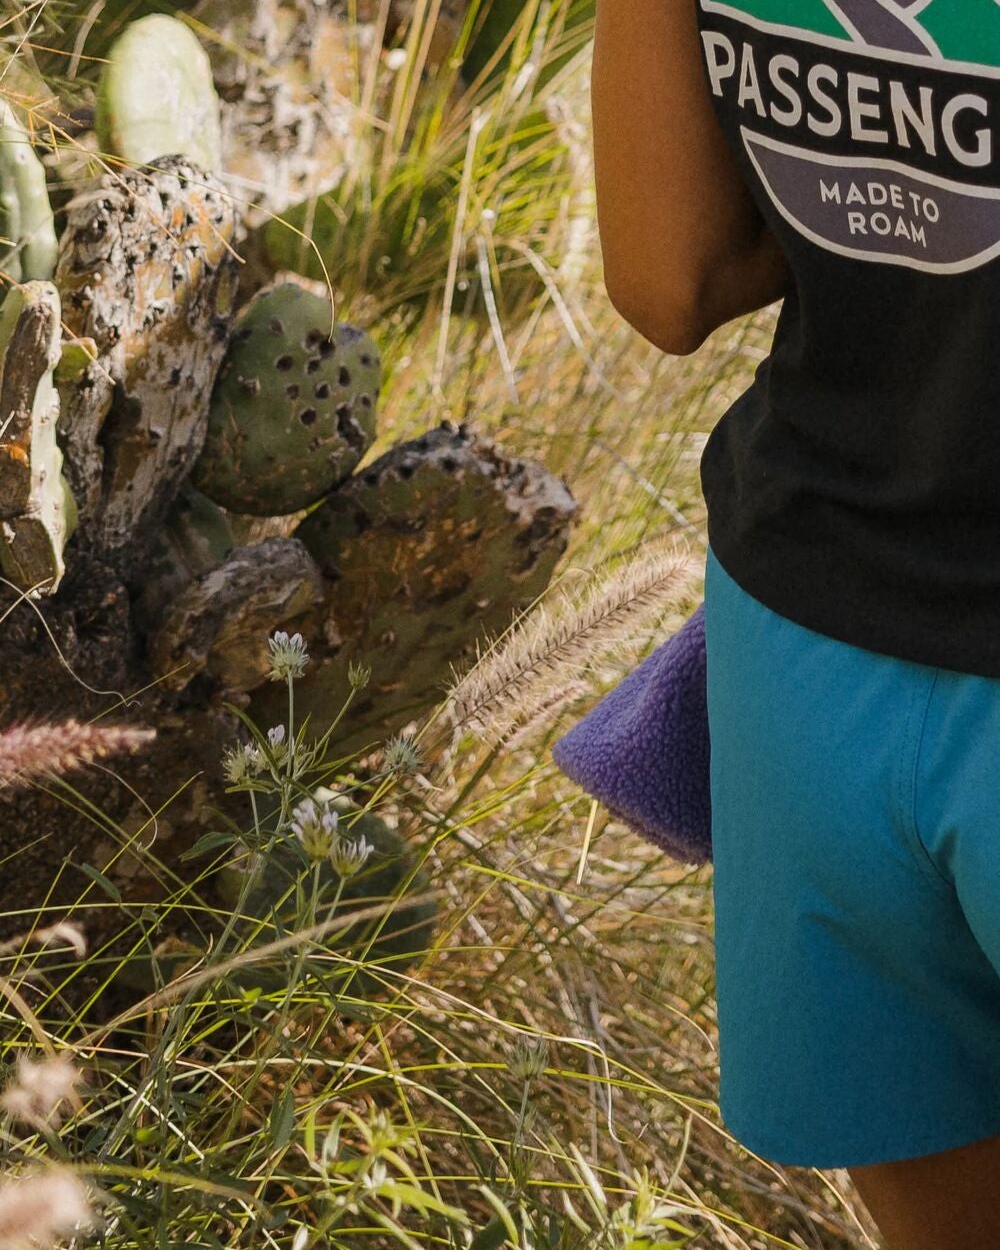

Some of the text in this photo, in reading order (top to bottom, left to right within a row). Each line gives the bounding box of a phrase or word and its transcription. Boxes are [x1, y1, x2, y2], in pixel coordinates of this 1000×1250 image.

[819, 179, 940, 223] MADE TO
[847, 211, 927, 248] ROAM
